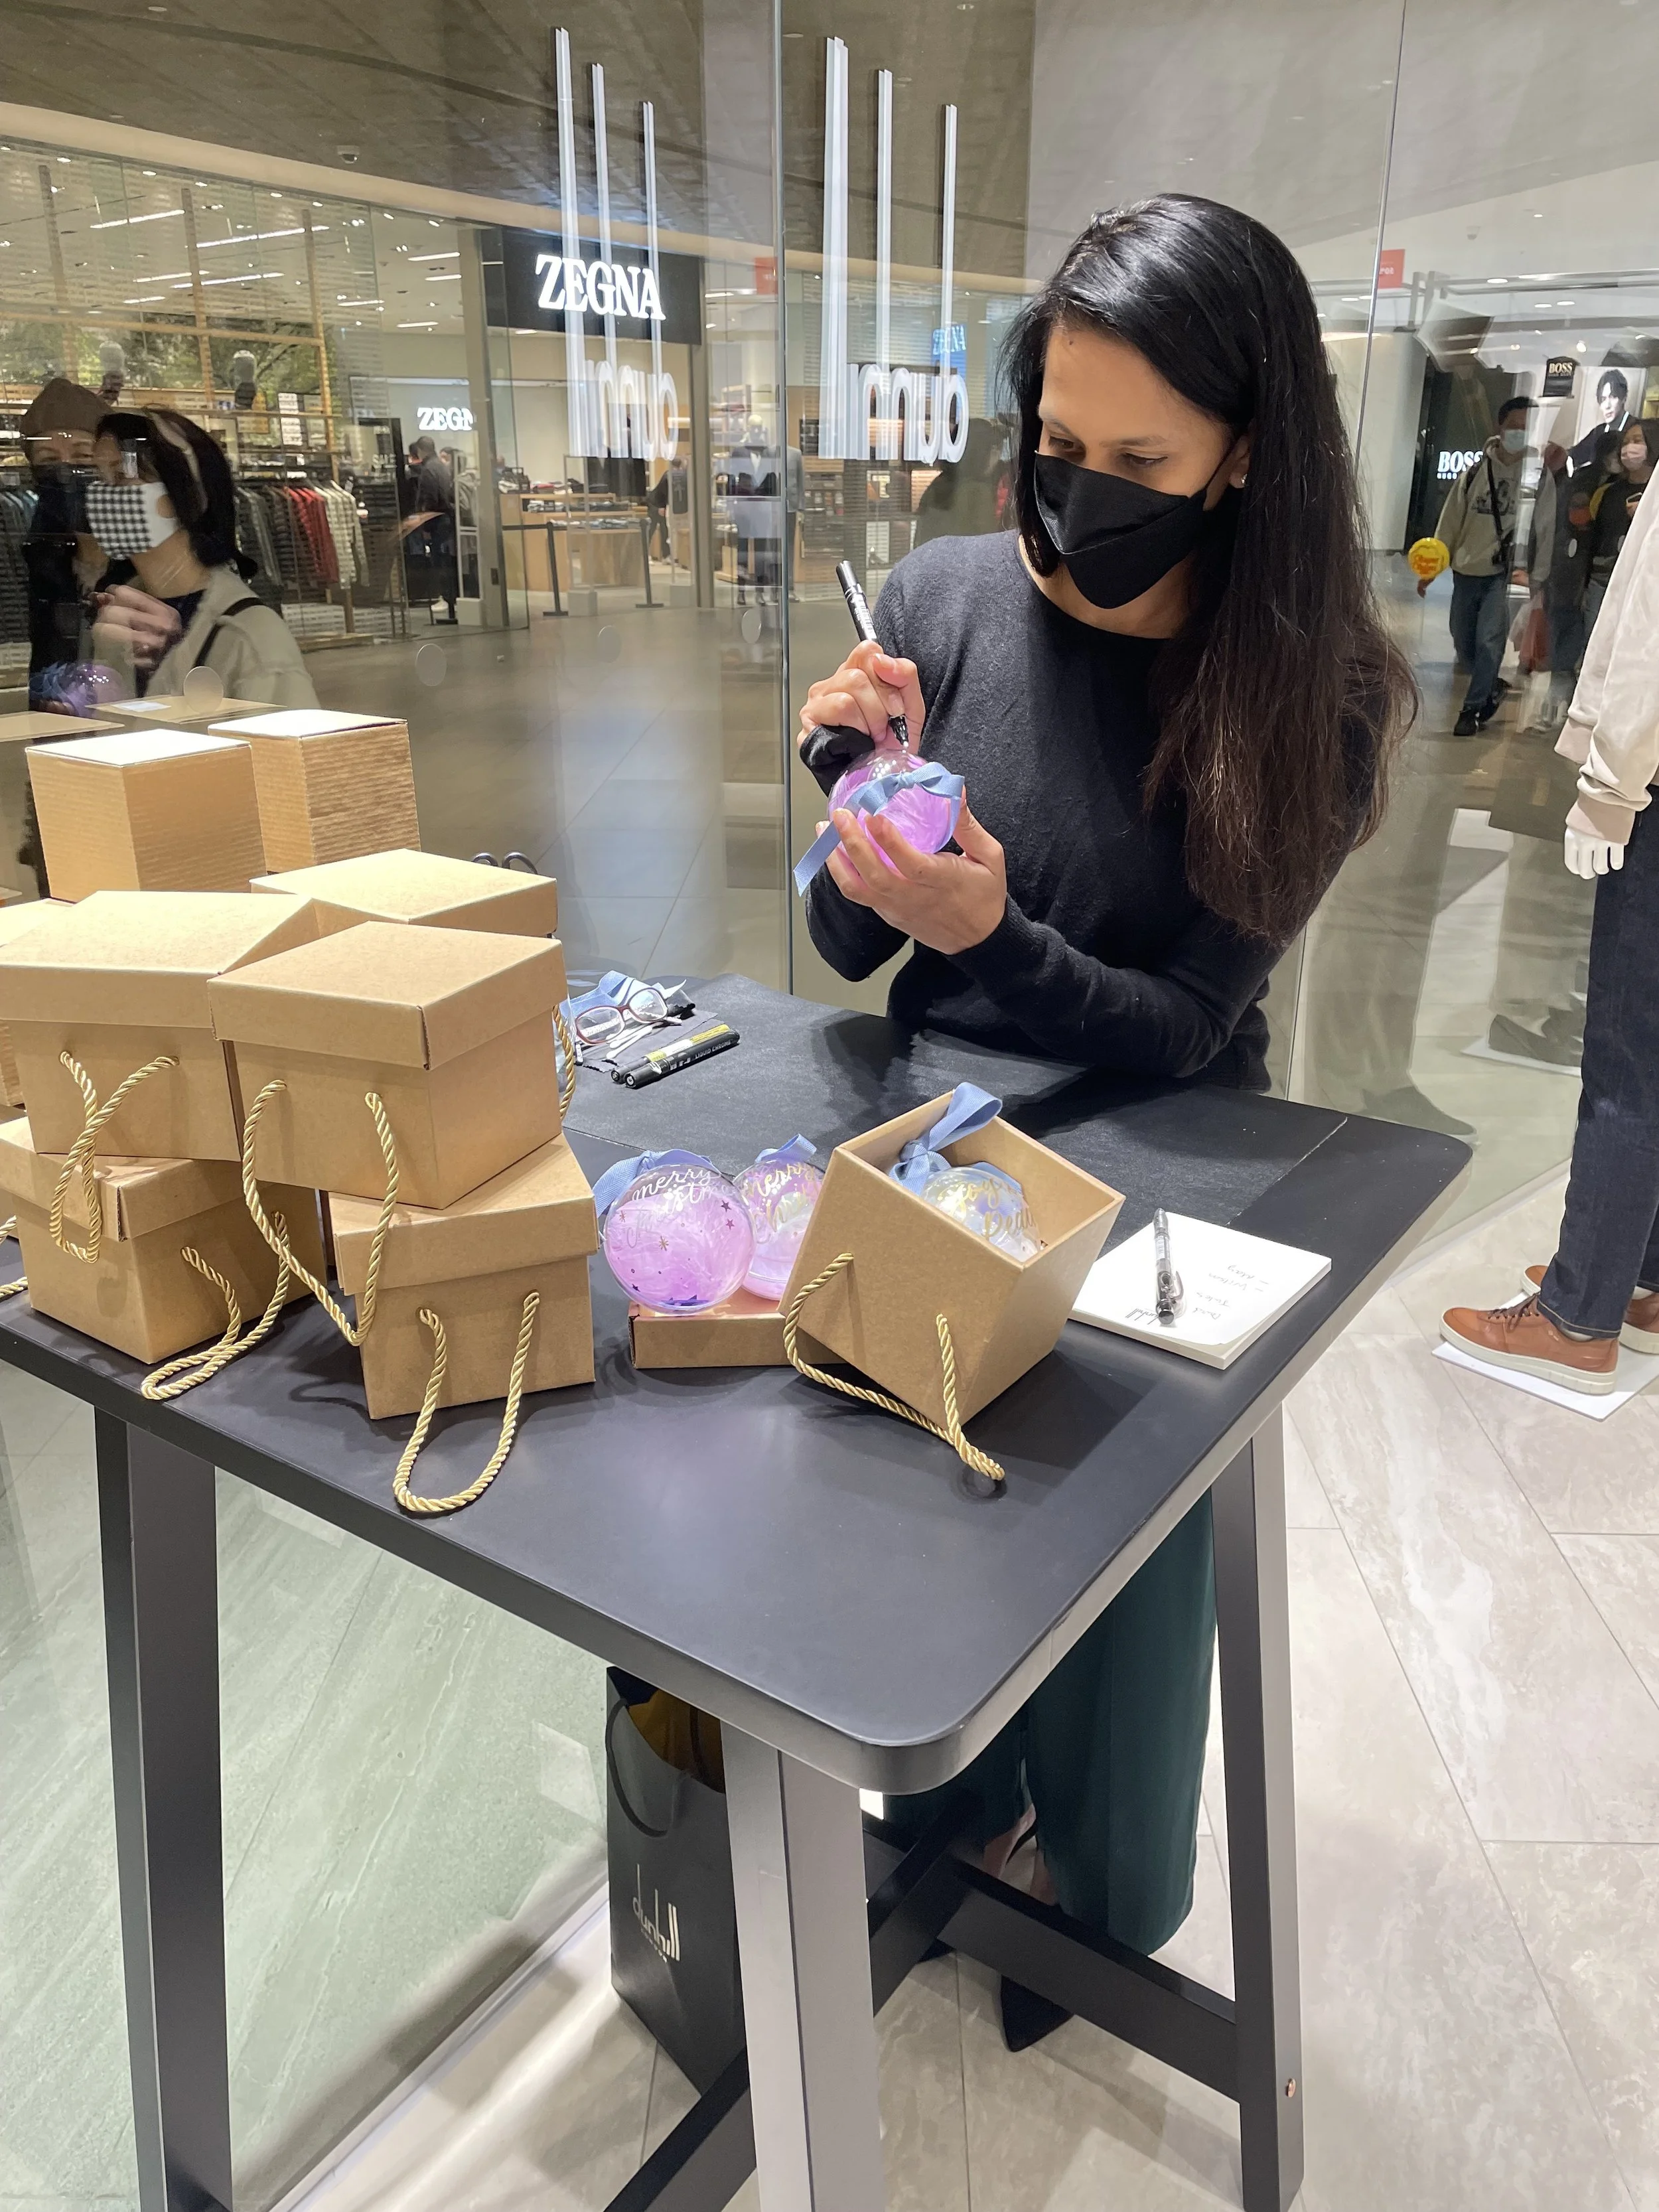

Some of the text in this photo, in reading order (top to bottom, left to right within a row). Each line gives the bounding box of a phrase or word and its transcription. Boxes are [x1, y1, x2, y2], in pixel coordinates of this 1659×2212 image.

[535, 254, 666, 320] ZEGNA
[1549, 362, 1573, 374] BOSS
[632, 1169, 722, 1201] merry
[632, 1863, 680, 1961] dunhill
